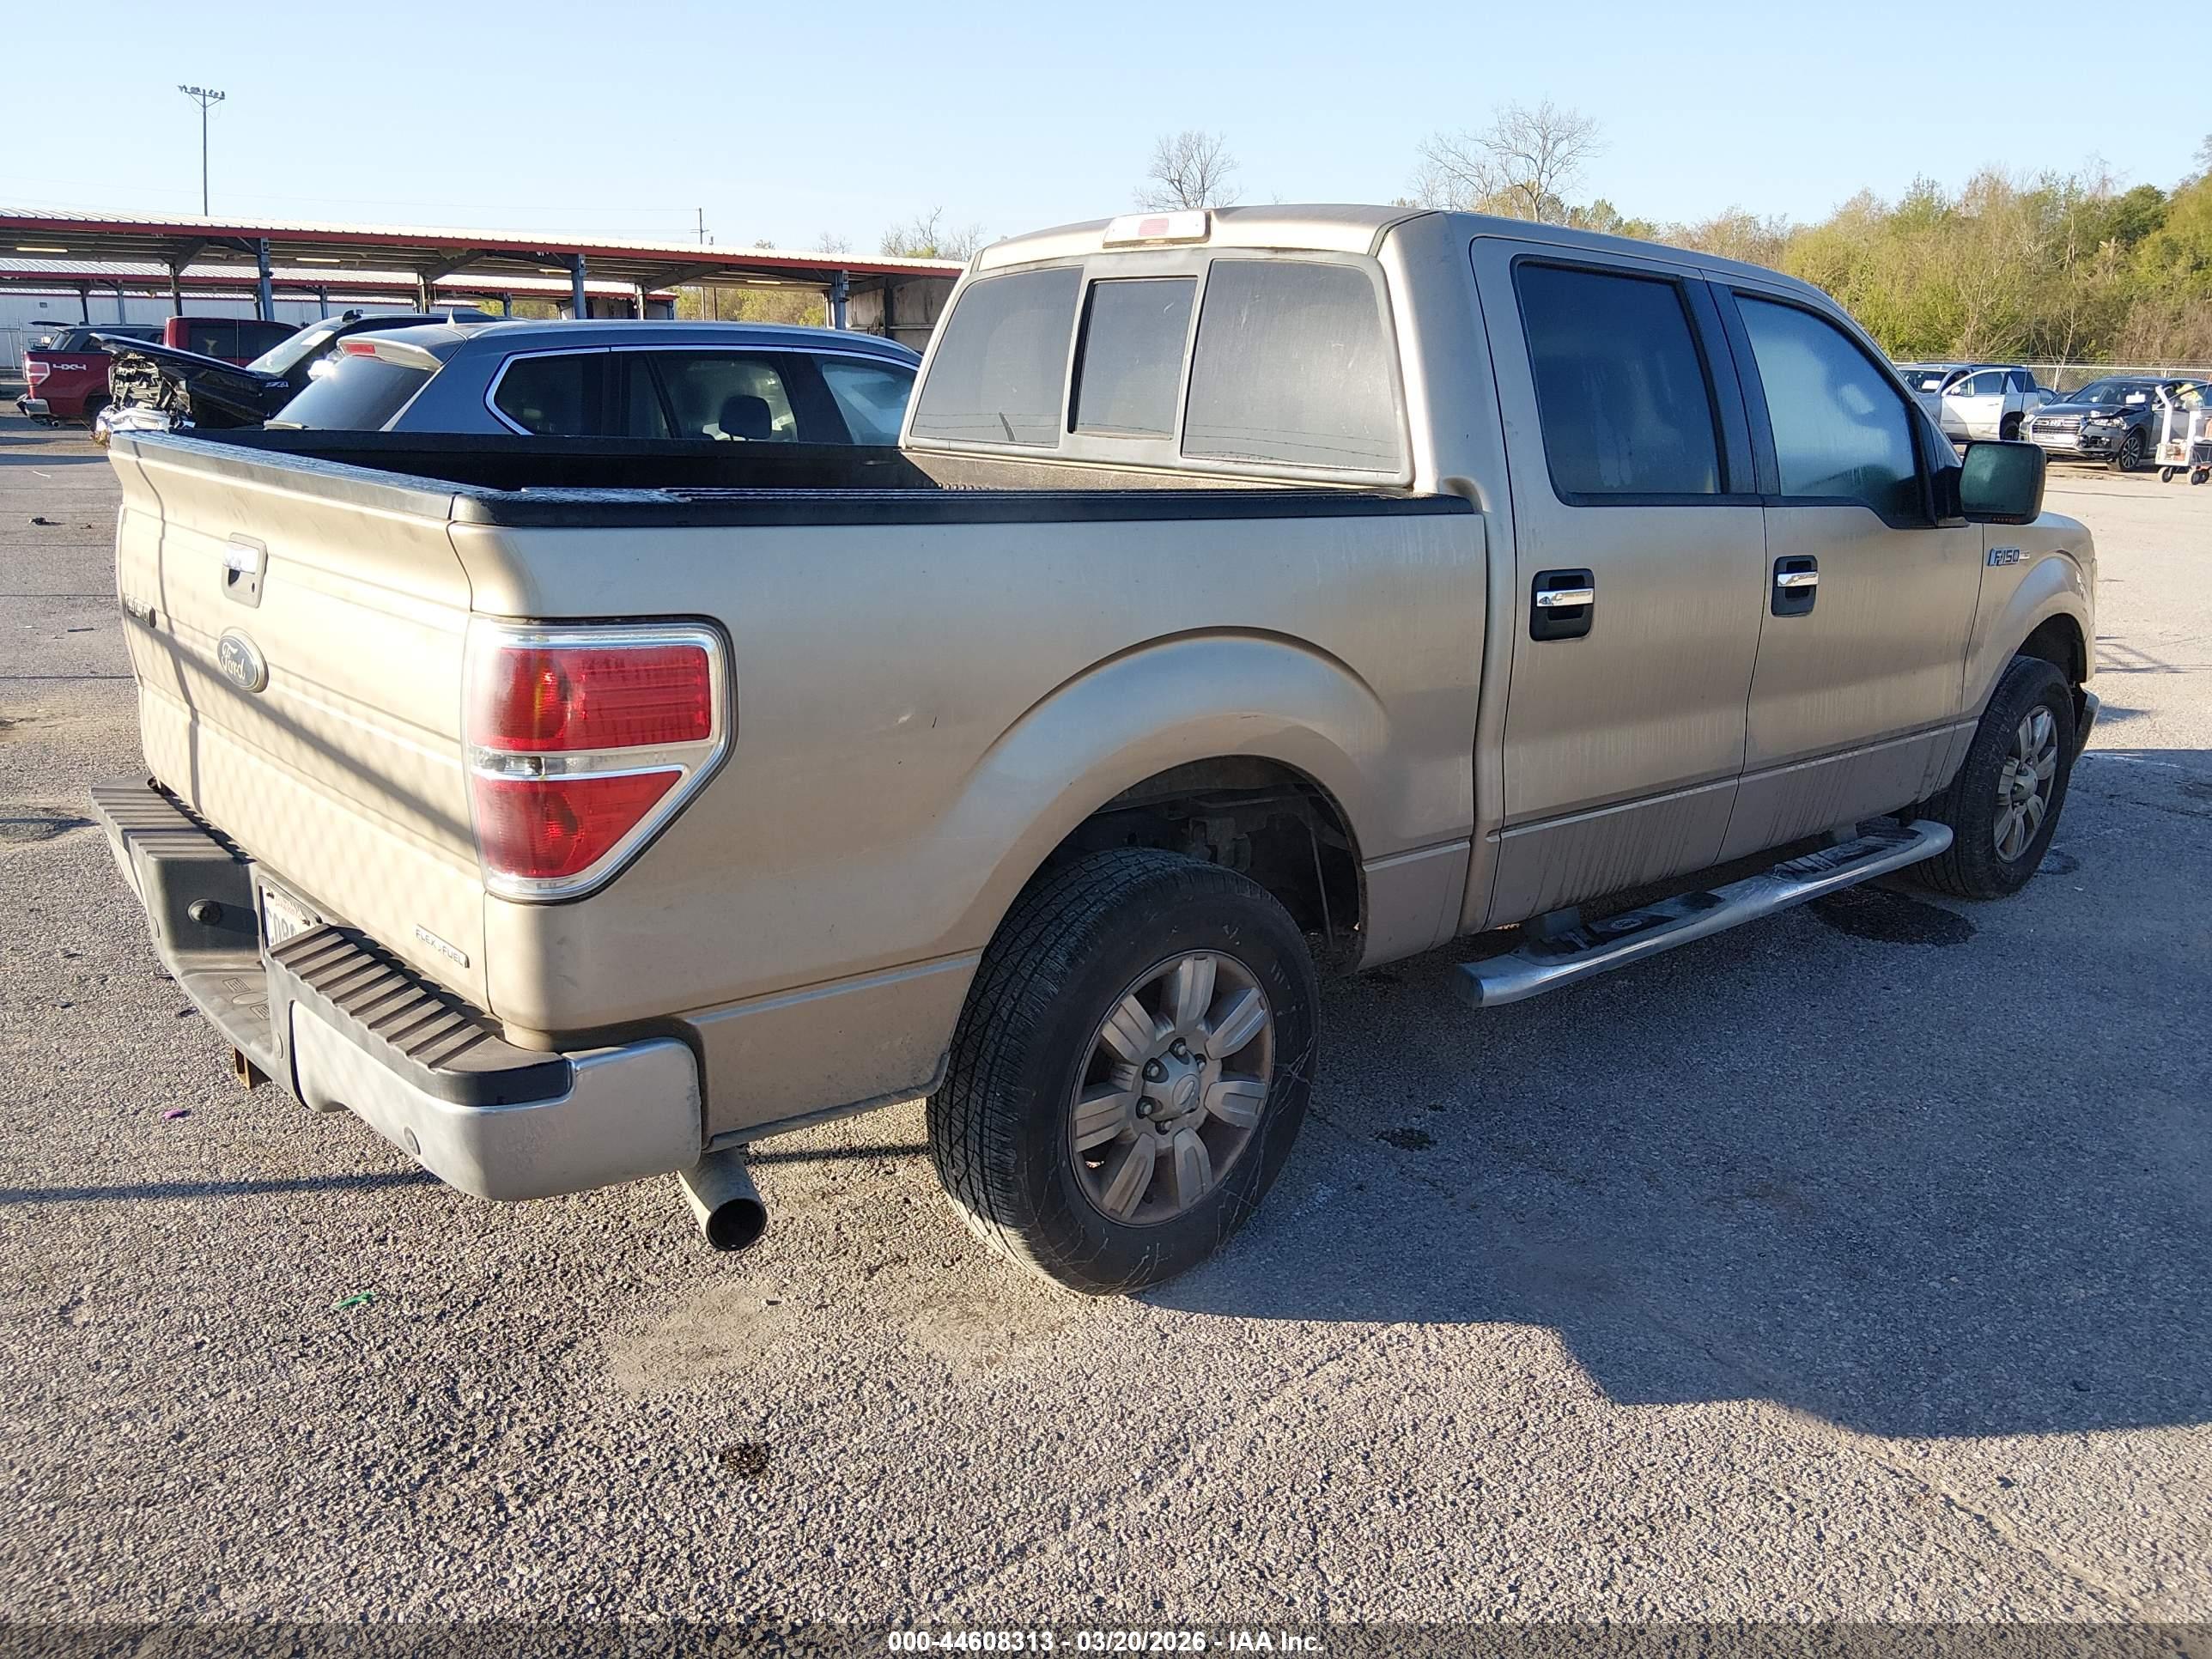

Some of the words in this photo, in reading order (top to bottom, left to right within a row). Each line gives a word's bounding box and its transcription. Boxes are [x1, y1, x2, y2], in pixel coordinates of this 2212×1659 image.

[221, 641, 246, 681] Ford
[416, 928, 436, 949] FLEX
[442, 945, 464, 967] FUEL
